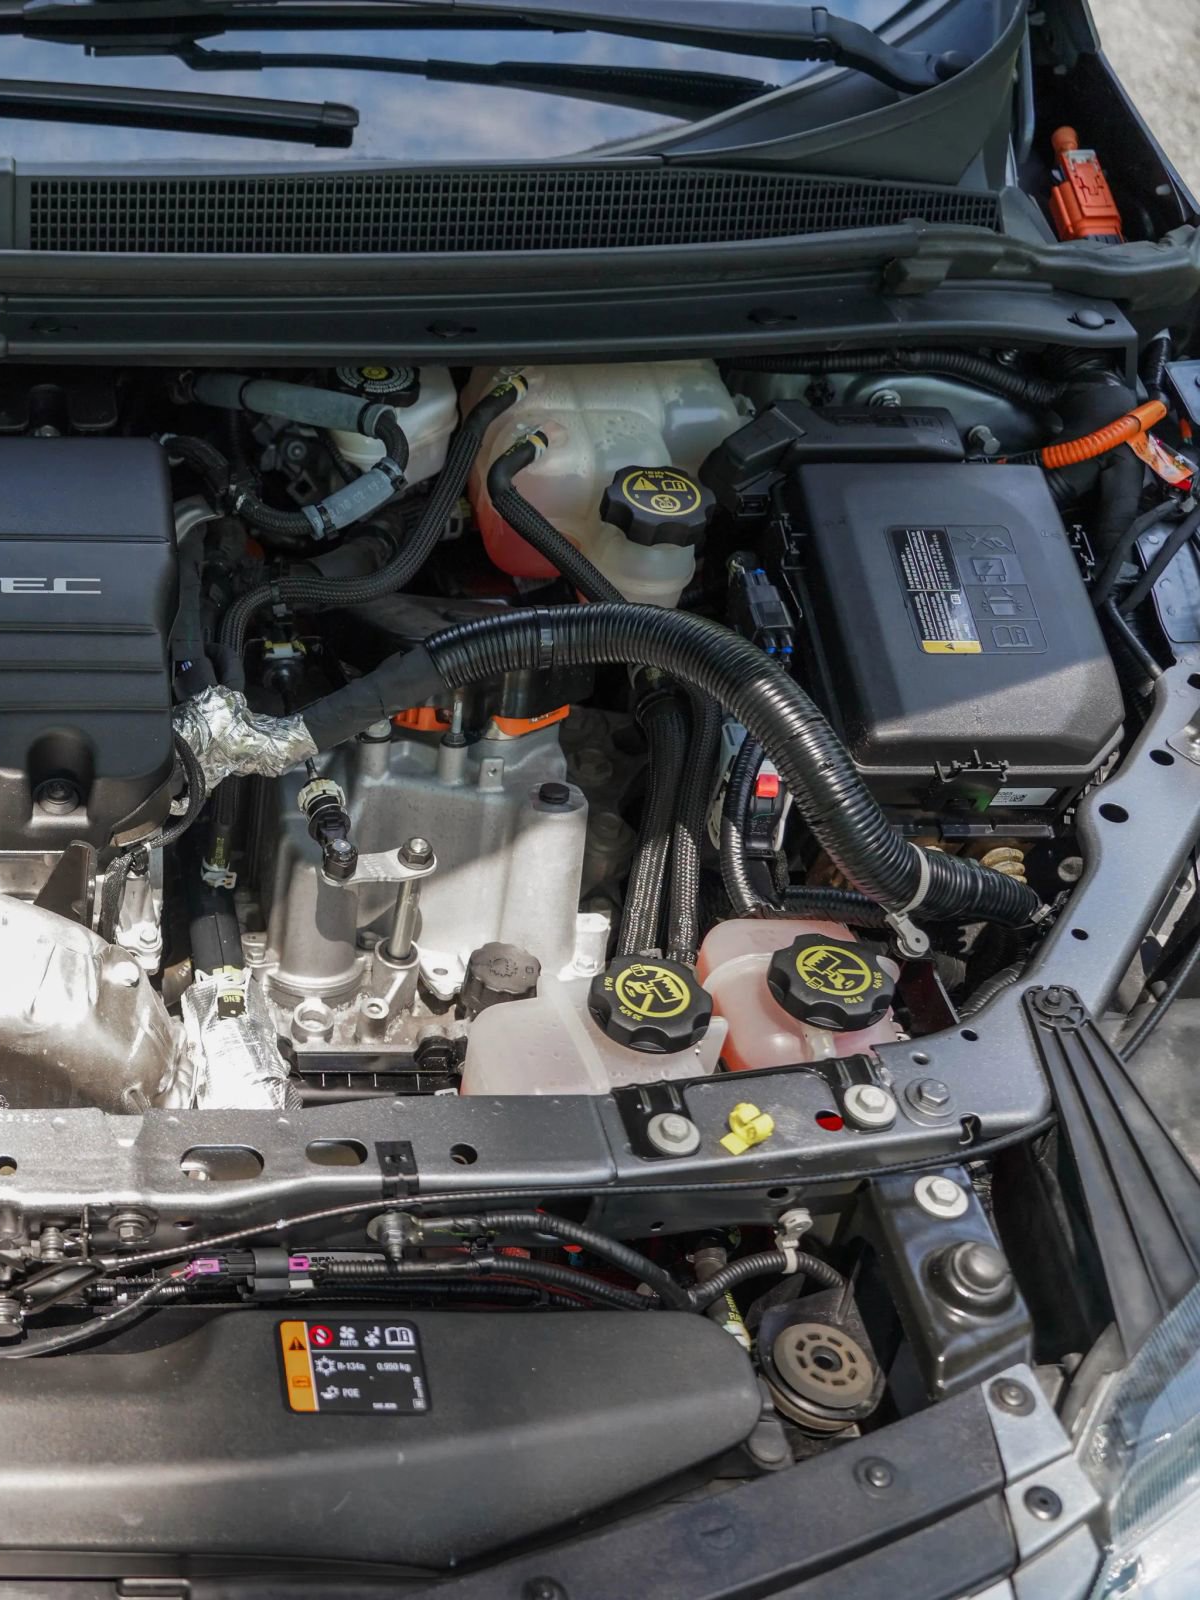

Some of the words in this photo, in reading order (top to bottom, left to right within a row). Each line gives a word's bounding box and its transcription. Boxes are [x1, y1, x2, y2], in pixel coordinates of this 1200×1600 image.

[337, 1362, 366, 1371] R-134a
[399, 1362, 411, 1372] kg
[342, 1388, 360, 1398] POE
